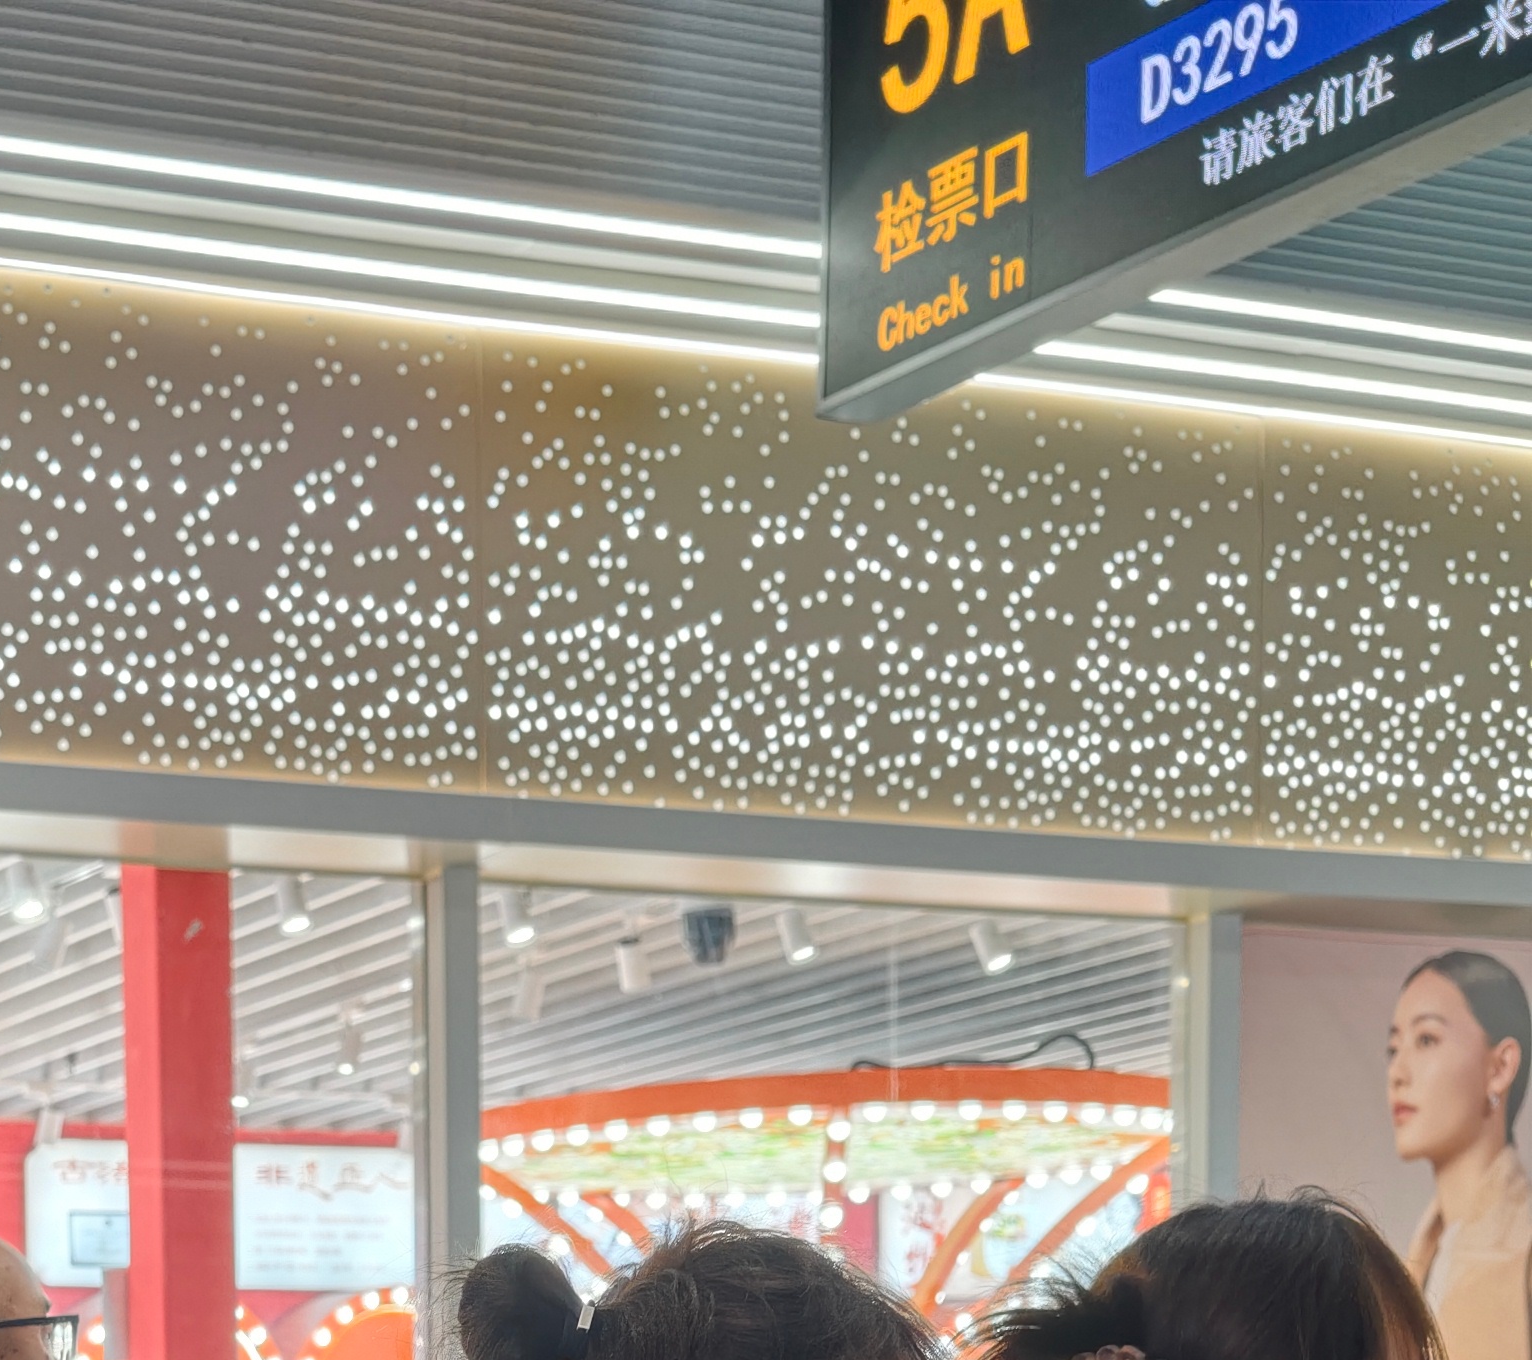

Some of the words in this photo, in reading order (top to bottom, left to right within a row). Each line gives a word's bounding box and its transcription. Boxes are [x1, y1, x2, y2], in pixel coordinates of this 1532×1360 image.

[1139, 2, 1299, 126] D3295
[1199, 0, 1532, 187] 请旅客们在“一米
[873, 131, 1030, 273] 检票口
[877, 275, 968, 352] Check
[990, 255, 1026, 300] in
